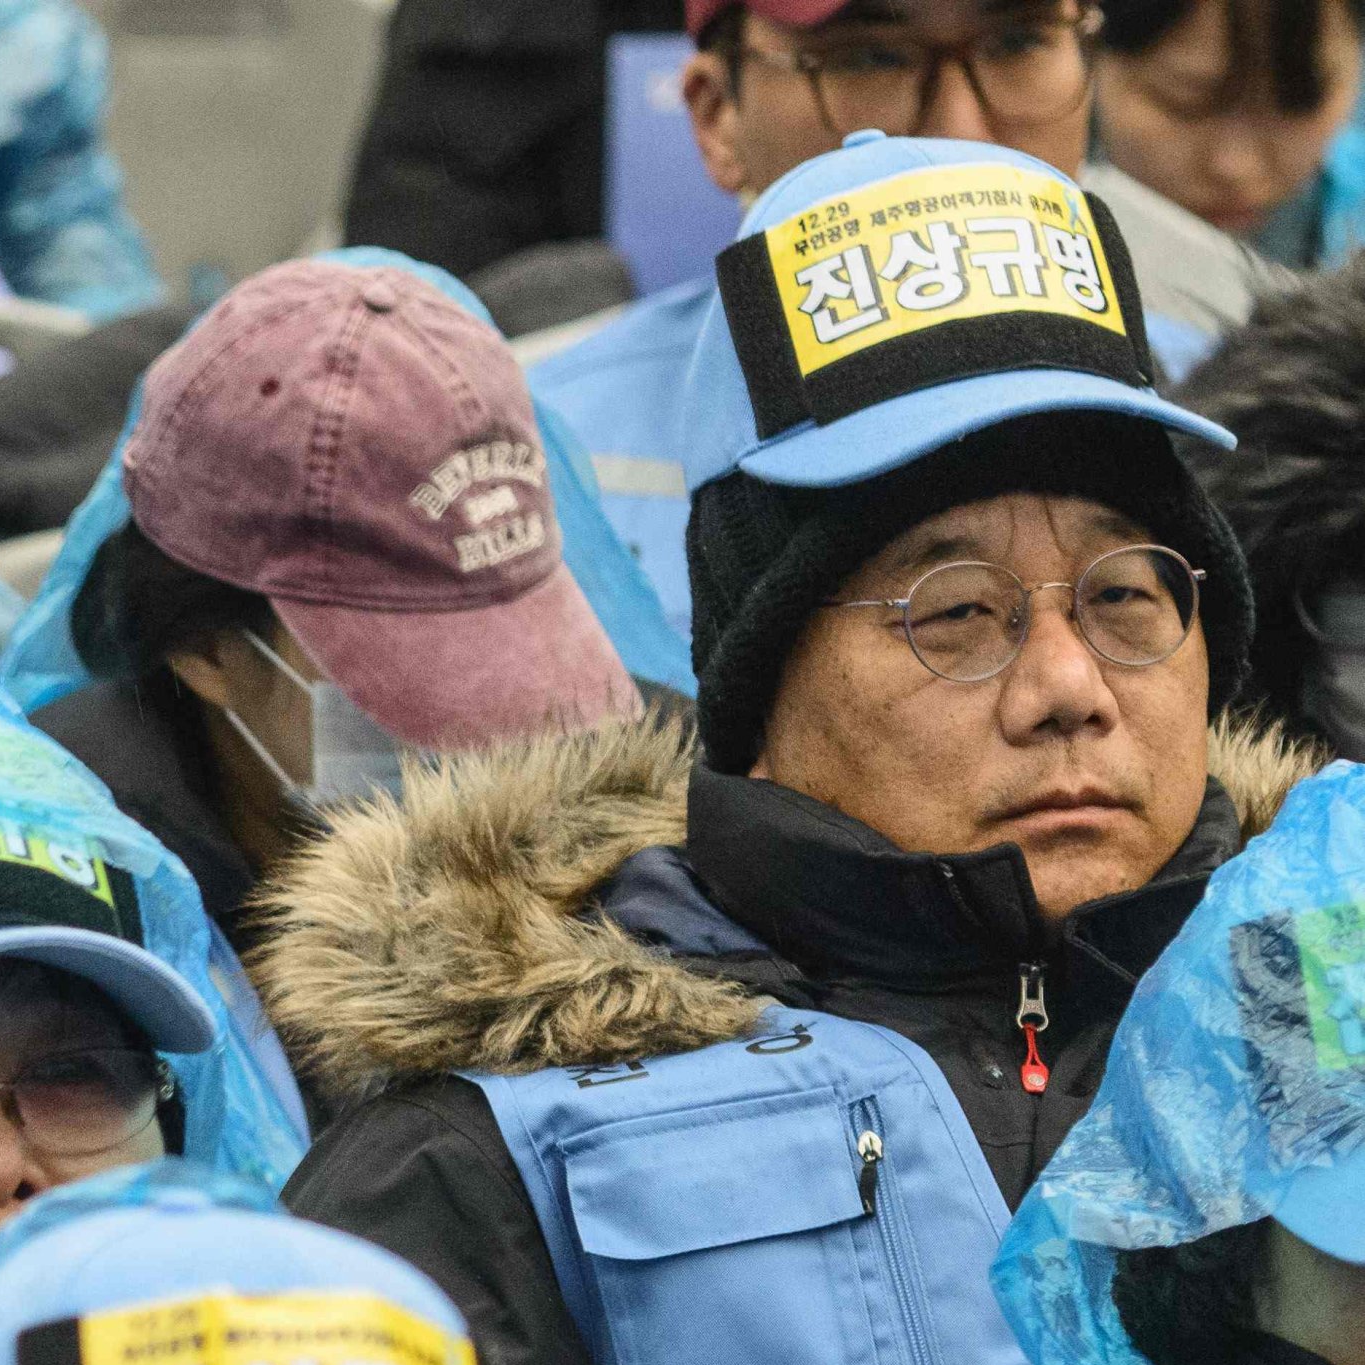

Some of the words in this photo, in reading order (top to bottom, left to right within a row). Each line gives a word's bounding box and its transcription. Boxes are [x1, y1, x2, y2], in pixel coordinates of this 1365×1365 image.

[797, 202, 850, 233] 12.29
[794, 218, 861, 256] 무안공항
[795, 215, 1108, 344] 진상규명
